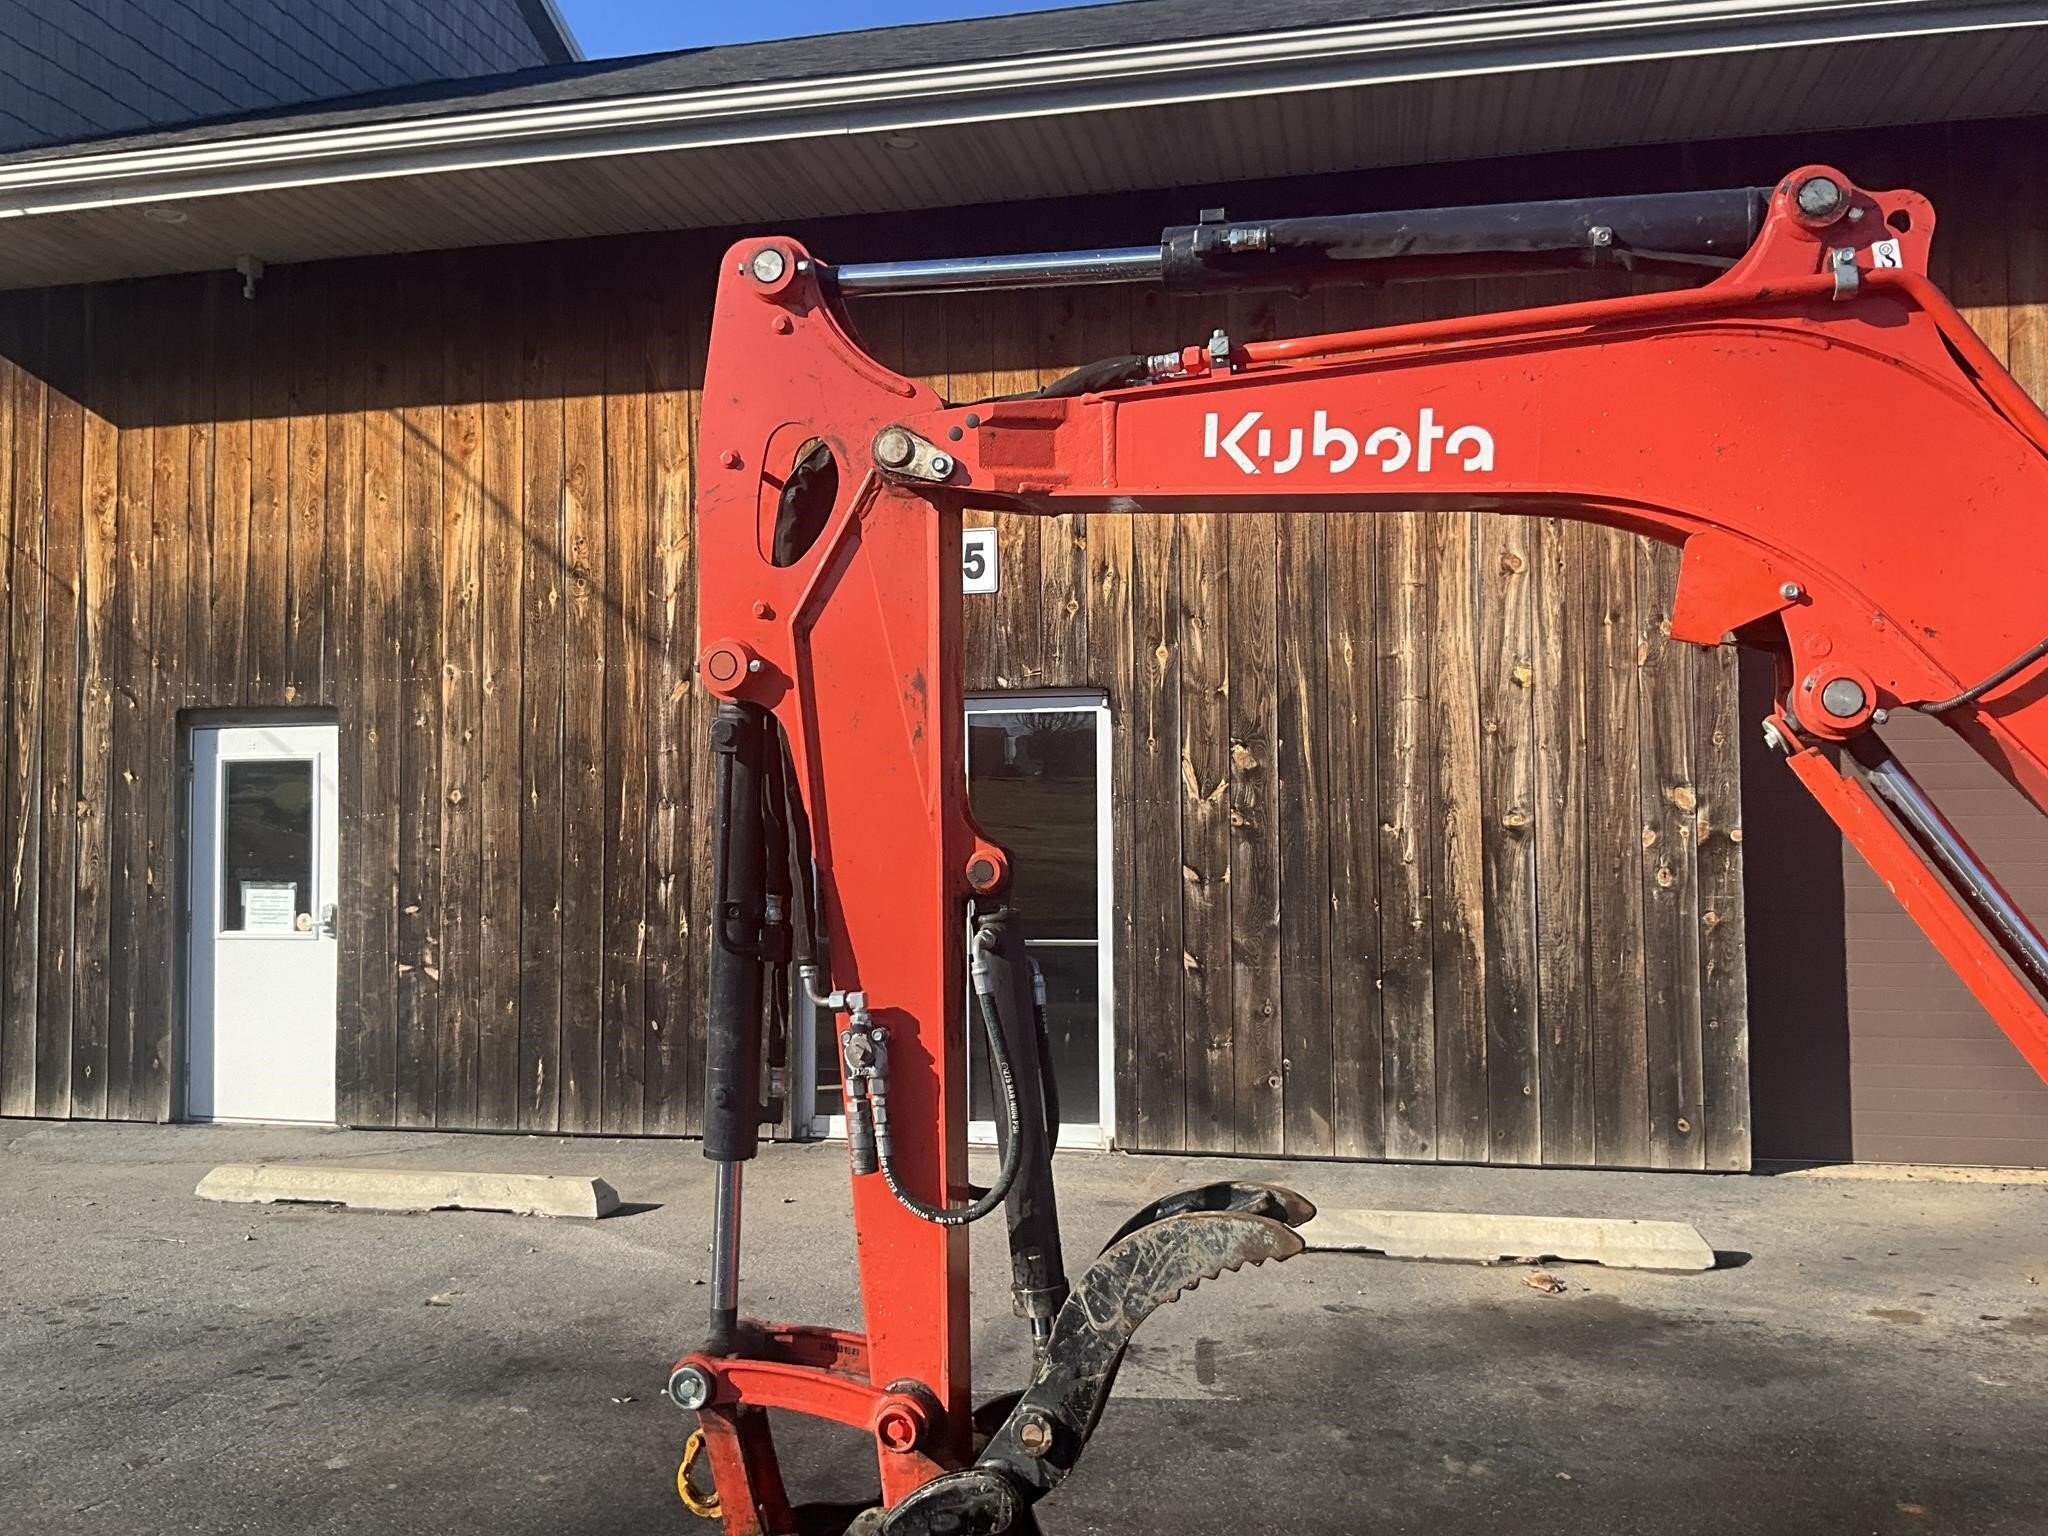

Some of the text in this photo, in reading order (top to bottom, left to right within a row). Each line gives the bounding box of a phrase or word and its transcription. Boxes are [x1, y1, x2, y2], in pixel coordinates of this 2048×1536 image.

[1203, 408, 1495, 474] Kubota
[963, 542, 986, 580] 5
[898, 1195, 930, 1220] WINNER
